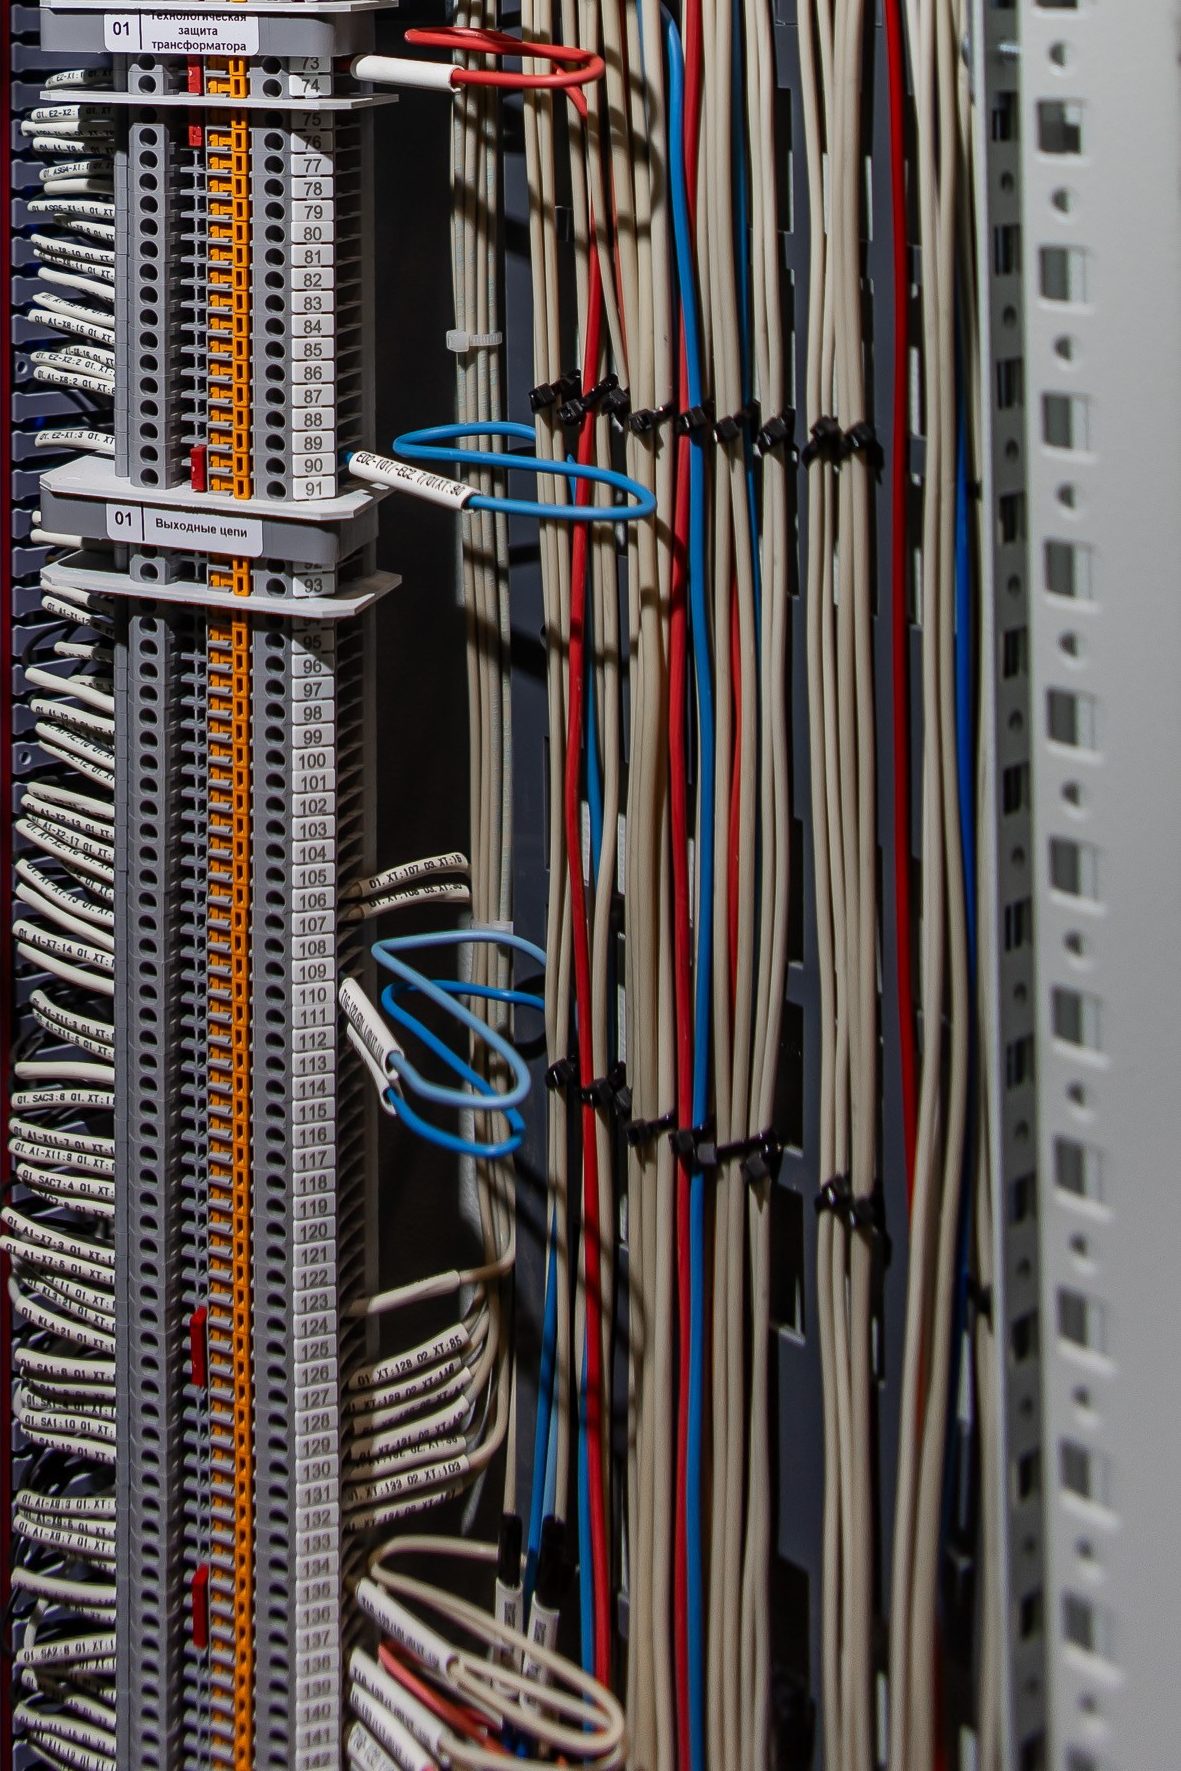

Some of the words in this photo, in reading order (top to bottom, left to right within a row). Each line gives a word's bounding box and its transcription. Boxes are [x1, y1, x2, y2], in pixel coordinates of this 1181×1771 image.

[113, 22, 130, 36] 01
[178, 26, 218, 38] защита
[151, 40, 247, 52] трансформатора
[301, 78, 320, 93] 74
[303, 158, 322, 173] 77
[304, 205, 323, 220] 79
[303, 273, 322, 288] 82
[304, 342, 322, 357] 85
[304, 412, 323, 428] 88
[305, 481, 321, 496] 91
[115, 511, 133, 526] 01
[155, 518, 217, 534] Выходные
[219, 526, 247, 539] цепи
[304, 578, 323, 593] 93
[303, 682, 322, 698] 97
[299, 752, 326, 770] 100
[300, 798, 327, 815] 102
[300, 868, 327, 886] 105
[299, 940, 326, 957] 108
